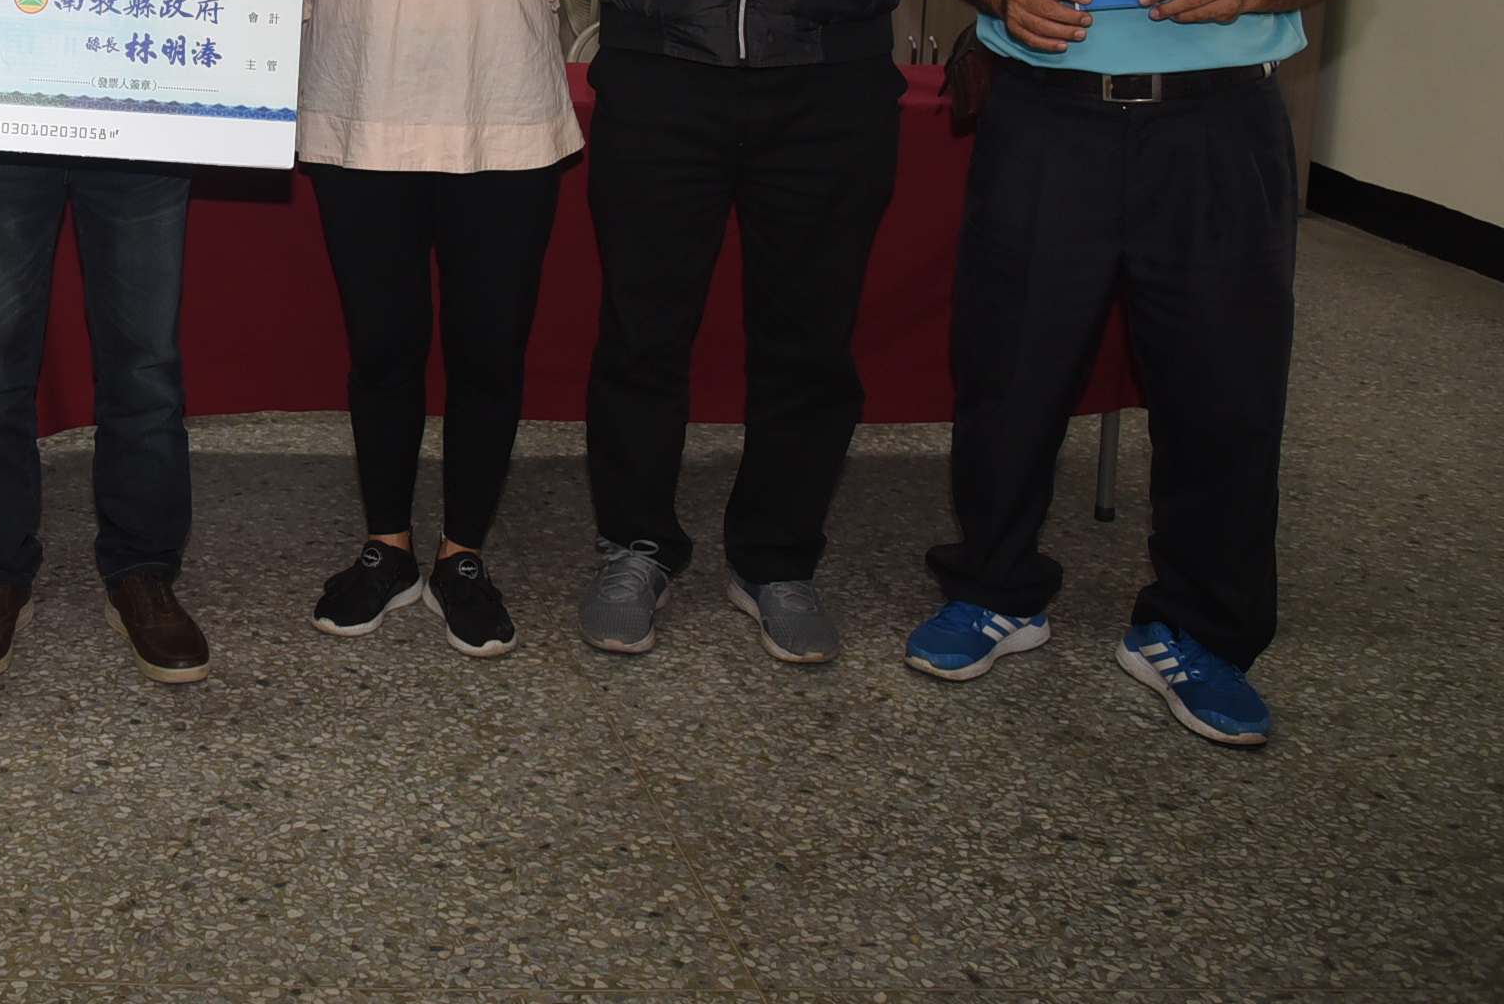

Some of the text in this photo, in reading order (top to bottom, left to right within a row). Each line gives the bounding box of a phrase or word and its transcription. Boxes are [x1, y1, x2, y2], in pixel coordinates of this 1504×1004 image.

[248, 11, 281, 25] 會計
[85, 32, 223, 69] 縣長 林明溱
[245, 58, 278, 72] 主管
